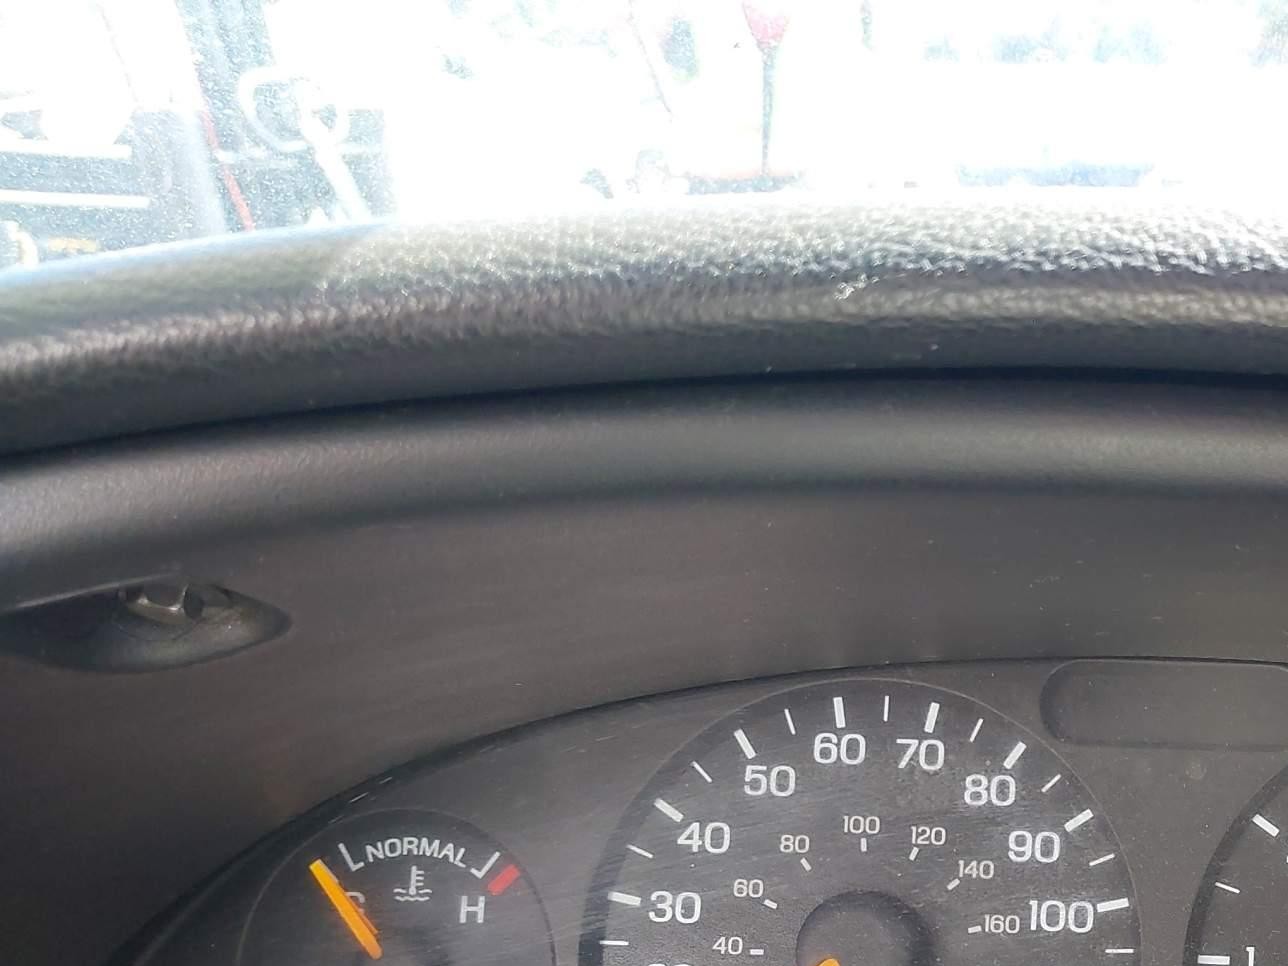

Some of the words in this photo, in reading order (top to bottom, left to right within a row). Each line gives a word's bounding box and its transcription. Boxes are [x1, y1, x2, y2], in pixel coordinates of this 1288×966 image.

[814, 733, 865, 764] 60
[897, 739, 944, 770] 70
[744, 765, 795, 796] 50
[964, 774, 1015, 806] 80
[677, 822, 730, 853] 40
[844, 816, 879, 833] 100
[912, 827, 945, 845] 120
[366, 837, 466, 869] NORMAL
[780, 835, 809, 853] 80
[1008, 831, 1060, 863] 90
[959, 860, 994, 879] 140
[734, 879, 763, 897] 60
[460, 896, 485, 923] H
[649, 891, 701, 923] 30
[1029, 900, 1093, 932] 100
[985, 915, 1019, 933] 160
[713, 937, 742, 954] 40
